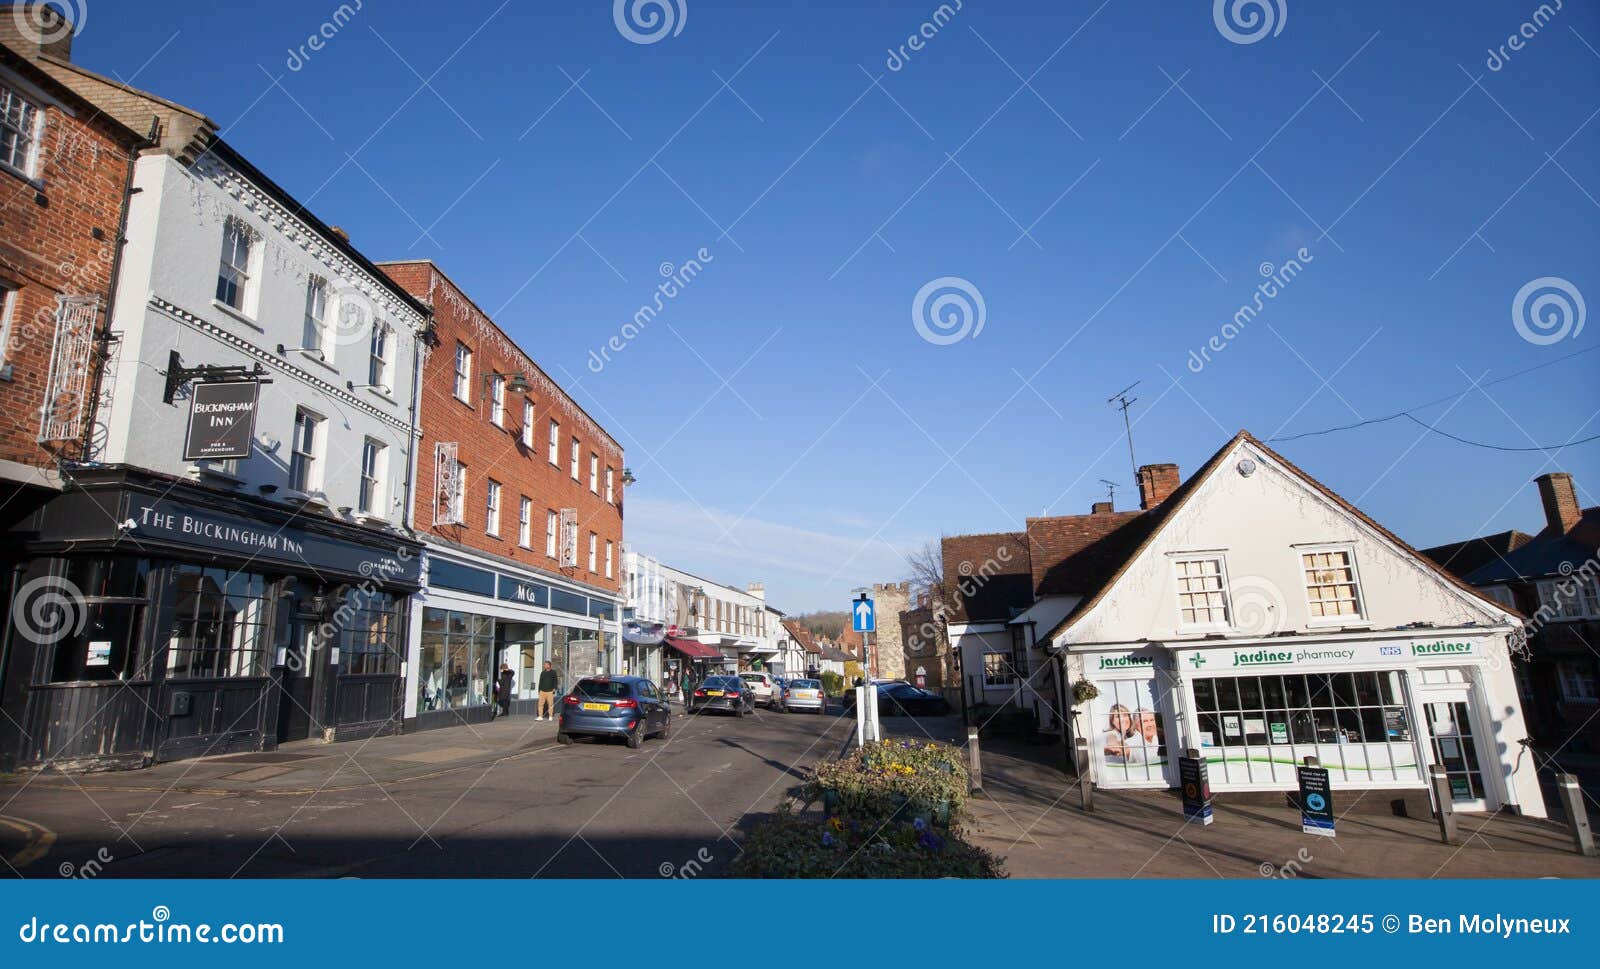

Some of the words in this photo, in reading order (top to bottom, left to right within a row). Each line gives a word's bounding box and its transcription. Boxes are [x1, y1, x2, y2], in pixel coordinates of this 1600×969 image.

[194, 402, 253, 413] BUCKINGHAM
[210, 415, 234, 427] INN
[140, 507, 175, 530] THE
[183, 516, 277, 549] BUCKINGHAM
[283, 537, 303, 554] INN
[1381, 647, 1400, 656] NHS
[1410, 640, 1472, 656] jardines
[1099, 655, 1153, 670] jardines
[1233, 650, 1292, 667] jardines
[1296, 649, 1355, 662] pharmacy
